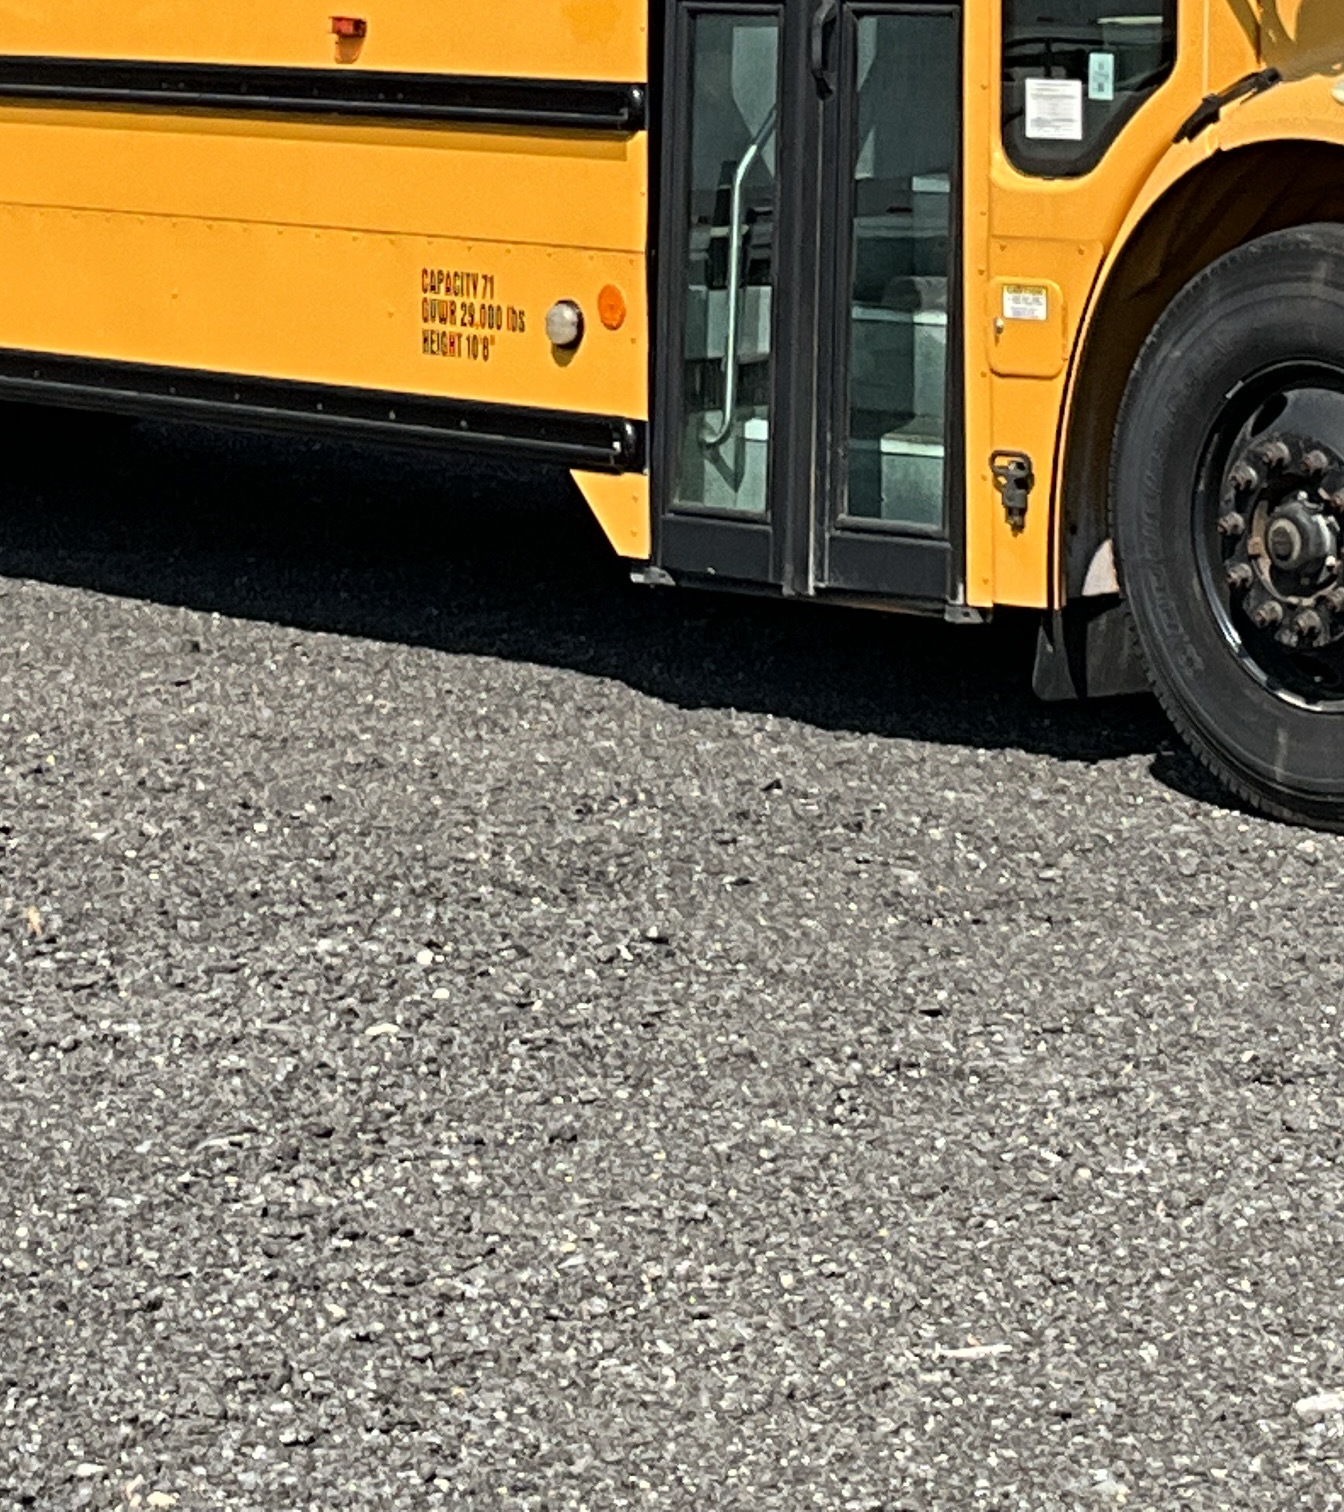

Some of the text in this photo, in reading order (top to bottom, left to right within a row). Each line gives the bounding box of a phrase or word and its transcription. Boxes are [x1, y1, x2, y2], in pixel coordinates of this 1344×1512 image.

[421, 268, 495, 300] CAPACITY 71
[421, 329, 463, 358] HEIGHT
